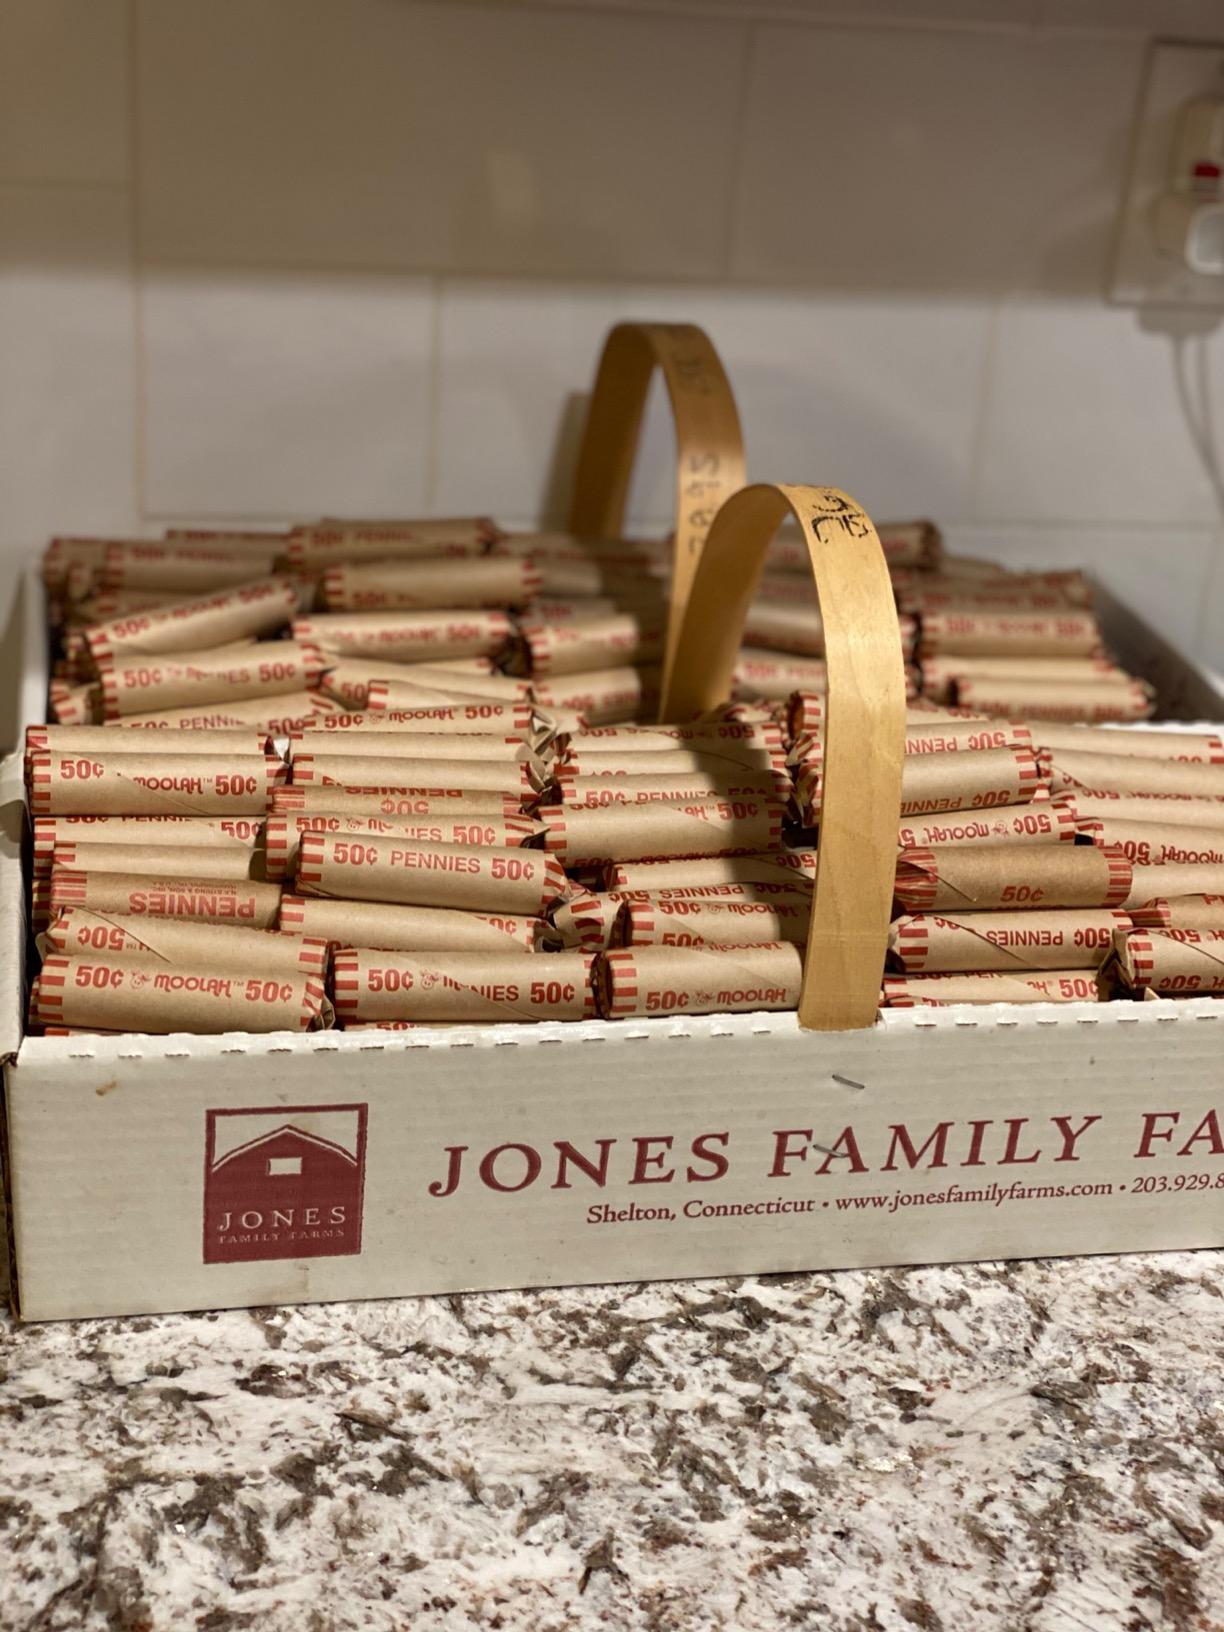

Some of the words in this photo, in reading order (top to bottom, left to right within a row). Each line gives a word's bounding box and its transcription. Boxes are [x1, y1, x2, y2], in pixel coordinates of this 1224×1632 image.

[123, 669, 162, 689] 50¢
[258, 662, 297, 683] 50¢
[324, 714, 364, 729] 50¢
[464, 705, 505, 720] 50¢
[968, 732, 1007, 750] 50¢
[60, 759, 104, 780] 50¢
[215, 775, 257, 796] 50¢
[972, 790, 1011, 806] 50¢
[718, 803, 758, 820] 50¢
[221, 821, 262, 840] 50¢
[296, 817, 340, 836] 50¢
[453, 825, 497, 846] 50¢
[1013, 814, 1052, 835] 50¢
[334, 843, 378, 866] 50¢
[391, 850, 481, 874] PENNIES
[492, 858, 534, 881] 50¢
[776, 854, 816, 868] 50¢
[659, 884, 745, 899] PENNIES
[1001, 886, 1045, 903] 50¢
[128, 892, 256, 918] PENNIES
[658, 901, 702, 916] 50¢
[77, 926, 125, 951] 50¢
[662, 932, 705, 947] 50¢
[986, 929, 1064, 946] PENNIES
[1074, 927, 1111, 949] 50¢
[75, 965, 124, 989] 50¢
[245, 979, 294, 1003] 50¢
[368, 968, 414, 993] 50¢
[530, 981, 575, 1004] 50¢
[1059, 978, 1099, 998] 50¢
[1159, 975, 1202, 990] 50¢
[645, 989, 690, 1011] 50¢
[716, 987, 787, 1004] MOOLAH
[428, 1131, 730, 1198] JONES
[767, 1114, 1103, 1178] FAMILY
[586, 1201, 677, 1225] Shelton,
[682, 1196, 816, 1219] Connecticut
[835, 1180, 1113, 1214] www.jonesfamilyfarms.com
[217, 1205, 346, 1232] JONES
[219, 1232, 280, 1244] FAMILY
